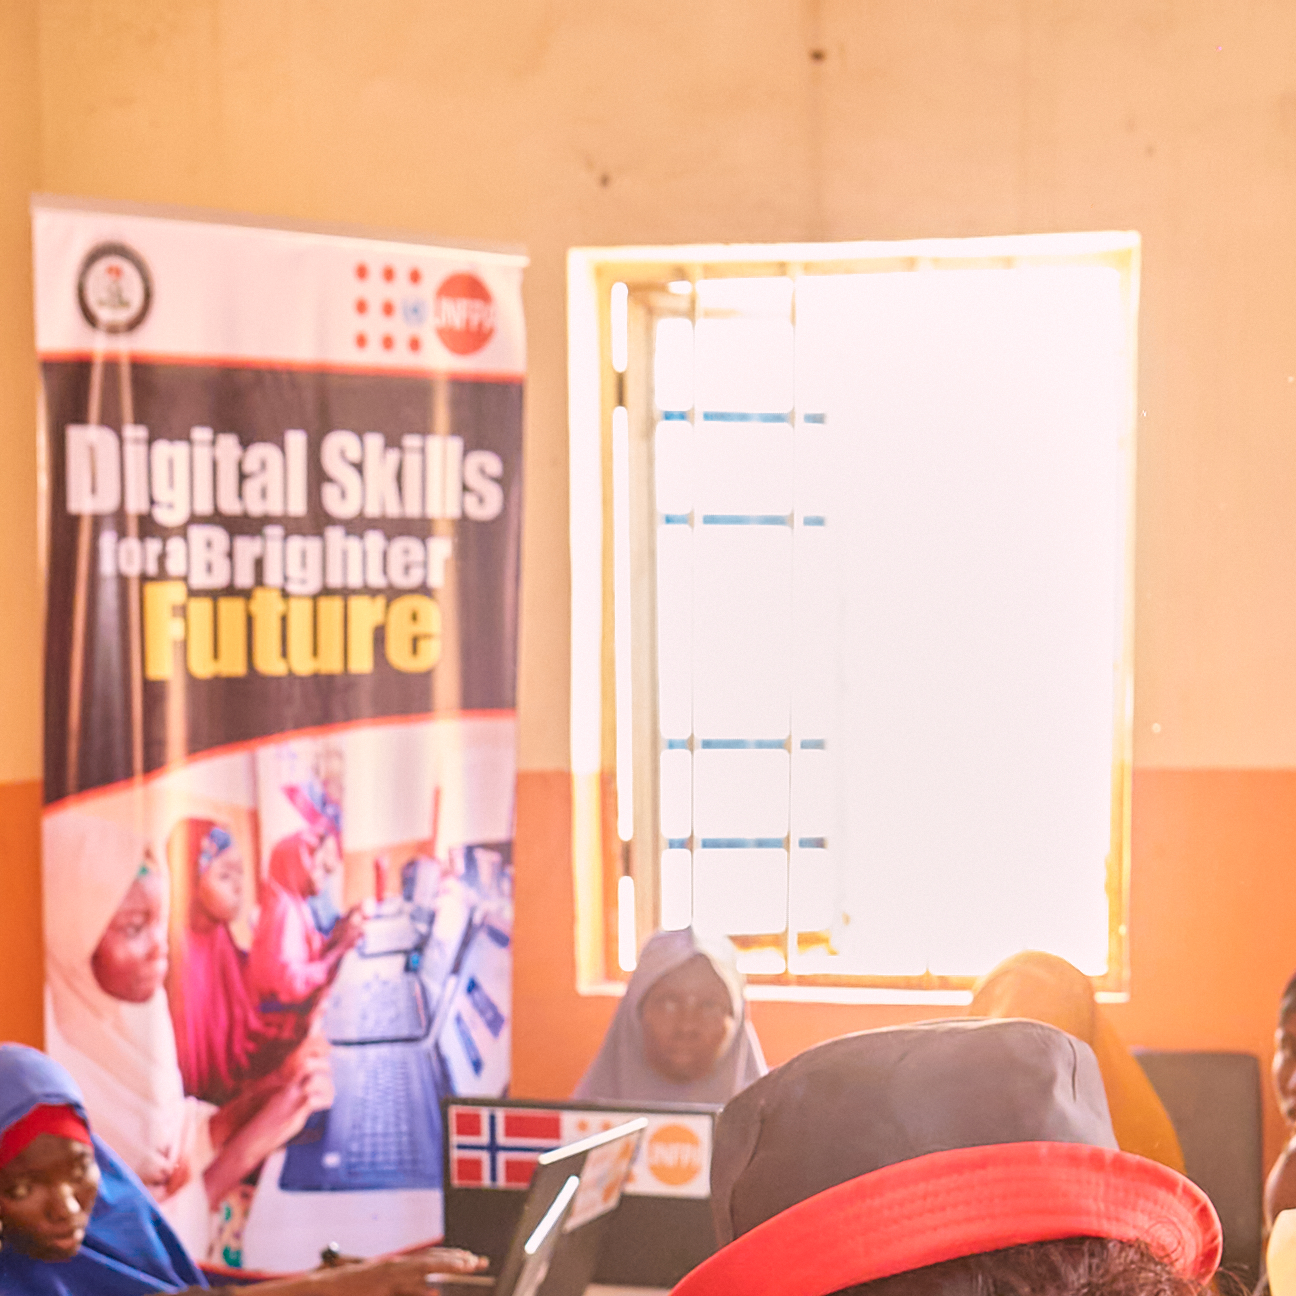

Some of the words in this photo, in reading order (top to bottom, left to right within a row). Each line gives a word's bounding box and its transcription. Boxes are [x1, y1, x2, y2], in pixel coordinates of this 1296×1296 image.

[65, 424, 308, 527] Digital
[320, 429, 505, 521] Skills
[186, 523, 455, 596] Brighter
[142, 580, 443, 681] Future
